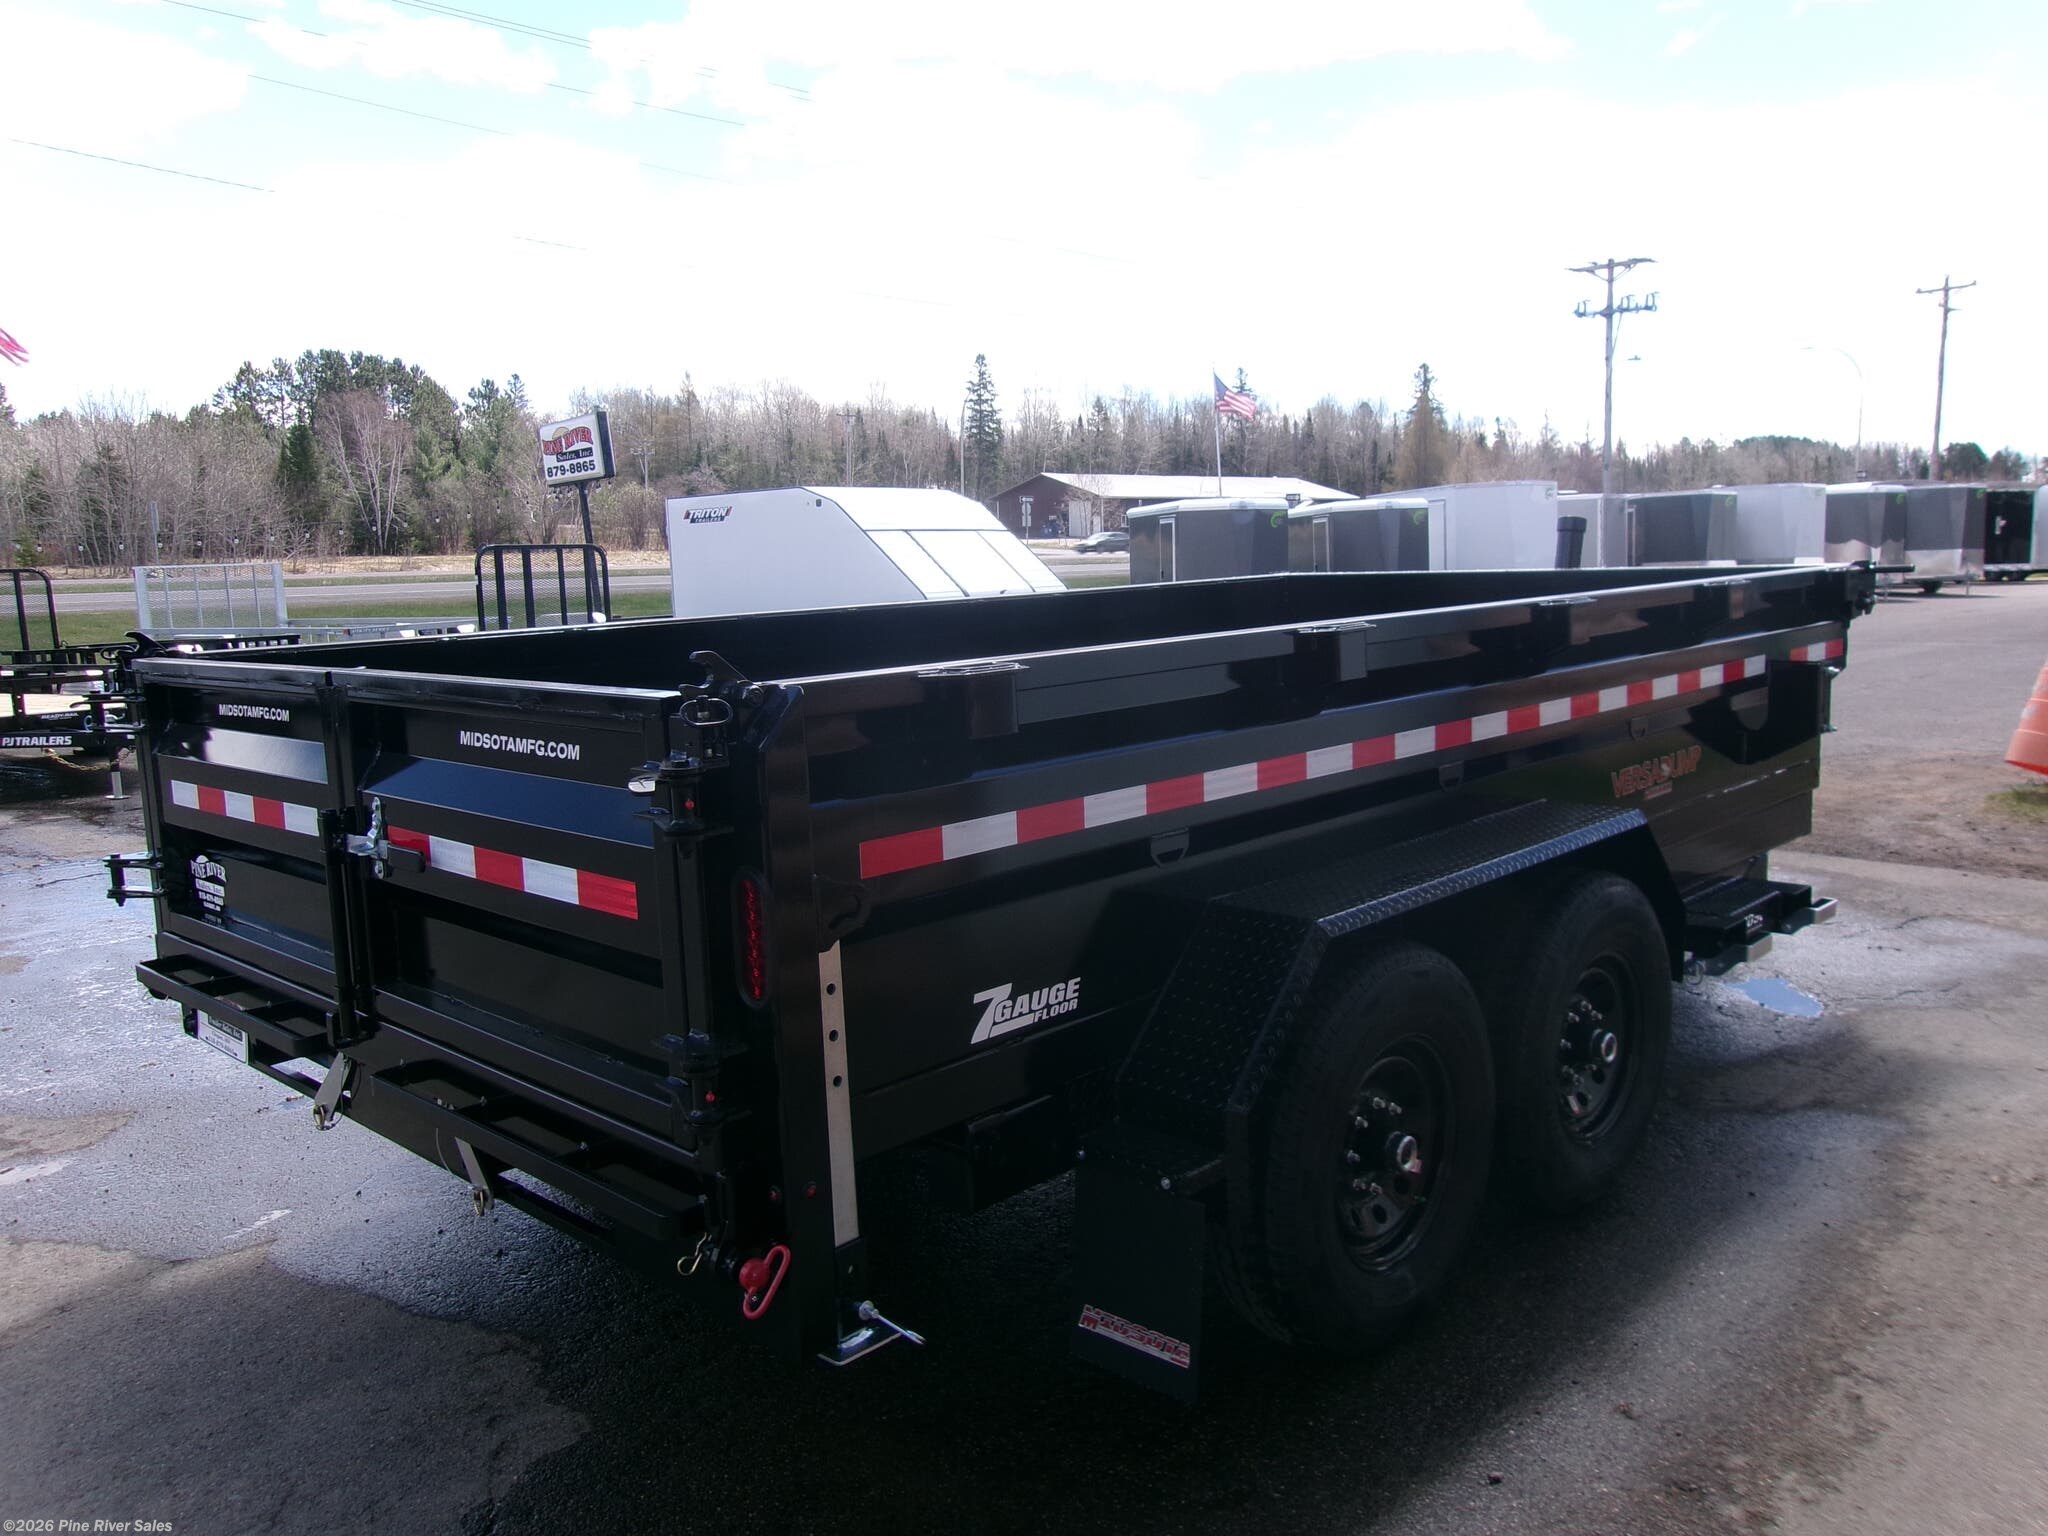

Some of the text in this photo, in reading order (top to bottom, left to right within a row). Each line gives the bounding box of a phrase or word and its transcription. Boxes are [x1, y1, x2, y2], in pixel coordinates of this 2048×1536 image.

[542, 426, 593, 456] PINE RIVER
[547, 459, 596, 478] 879-8865
[689, 507, 728, 519] TRITON
[218, 703, 290, 722] MIDSOTAMFG.COM
[2, 735, 72, 747] PJ TRAILERS
[460, 730, 580, 761] MIDSOTAMFG.COM
[190, 859, 227, 883] PINE RIVER
[994, 977, 1081, 1023] GAUGE
[1034, 998, 1078, 1023] FLOOR
